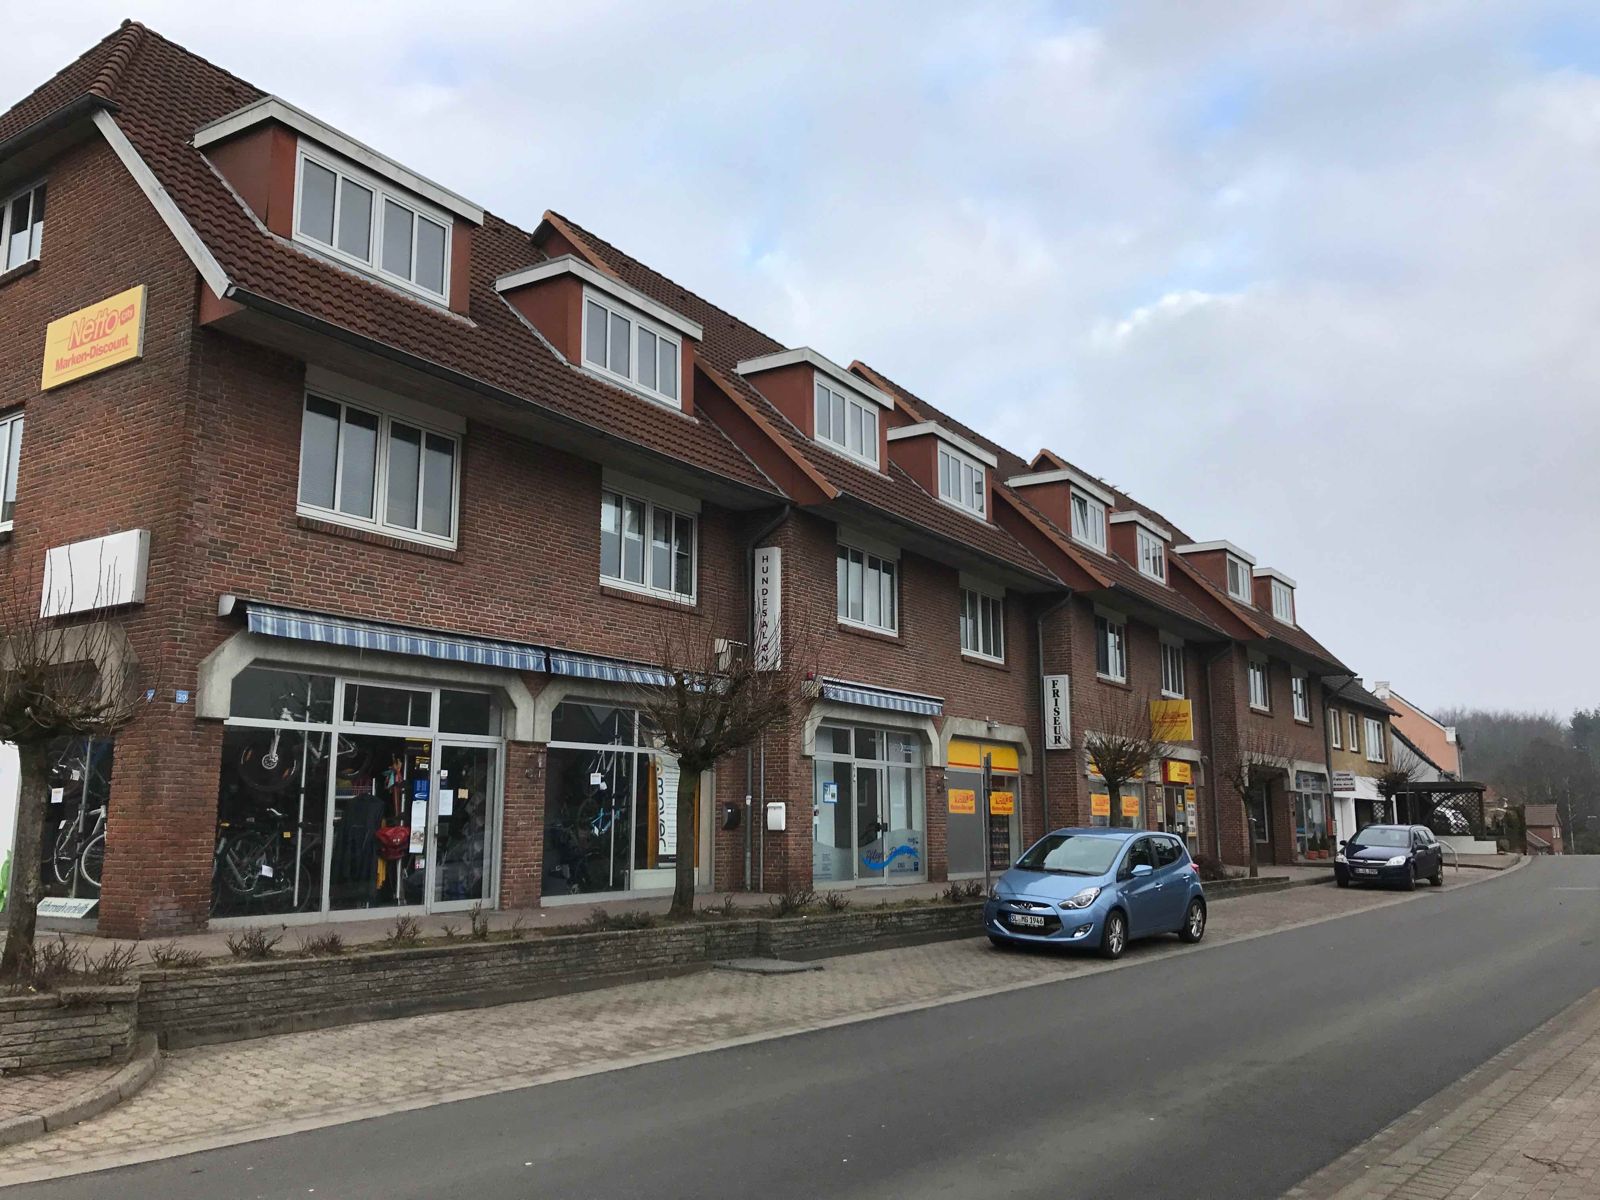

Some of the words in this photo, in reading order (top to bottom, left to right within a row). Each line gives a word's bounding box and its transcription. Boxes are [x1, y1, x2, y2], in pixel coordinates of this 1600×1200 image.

[69, 308, 119, 351] Netto
[55, 334, 129, 371] Marken-Discount
[1052, 679, 1062, 745] FRISEUR
